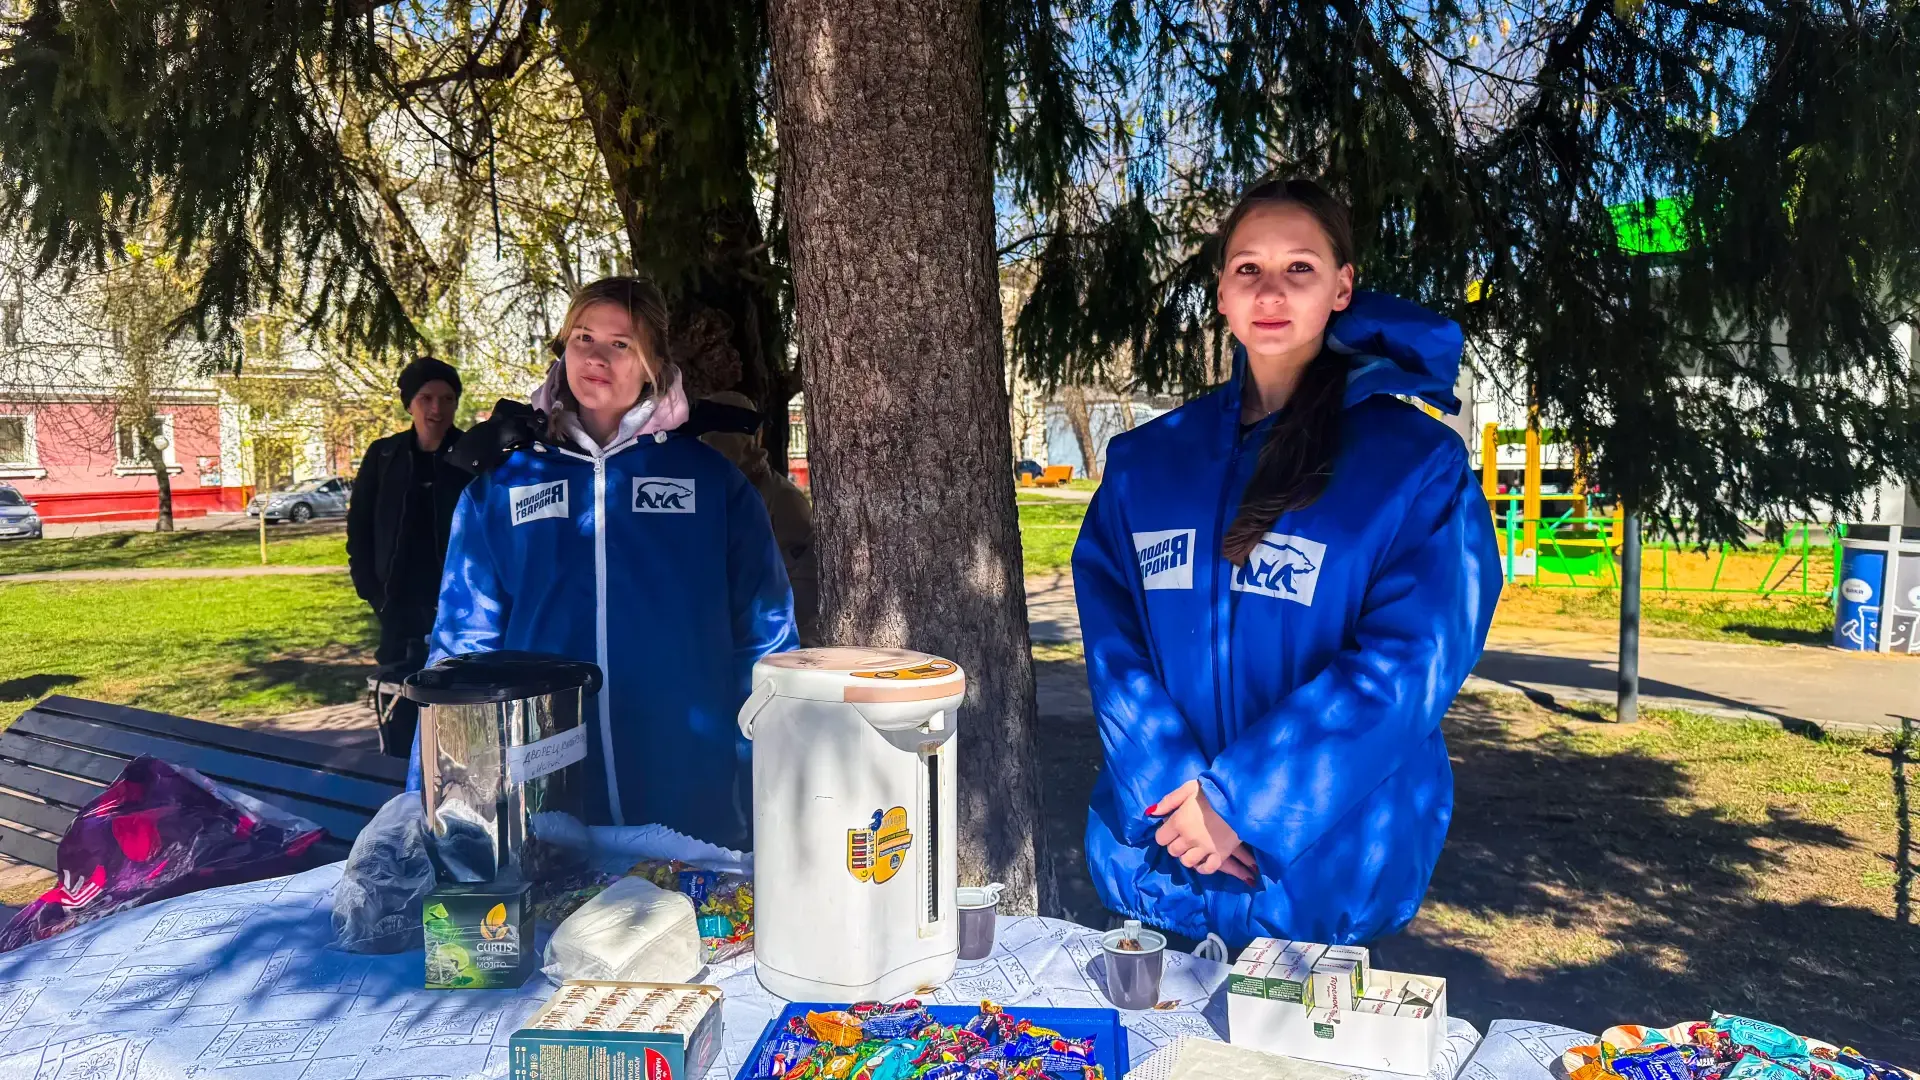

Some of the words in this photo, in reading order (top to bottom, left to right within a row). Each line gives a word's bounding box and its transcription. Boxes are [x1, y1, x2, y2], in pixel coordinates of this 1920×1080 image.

[1137, 533, 1189, 567] ЛОДАЯ
[476, 943, 513, 953] CURTIS
[476, 961, 507, 969] MOJITO
